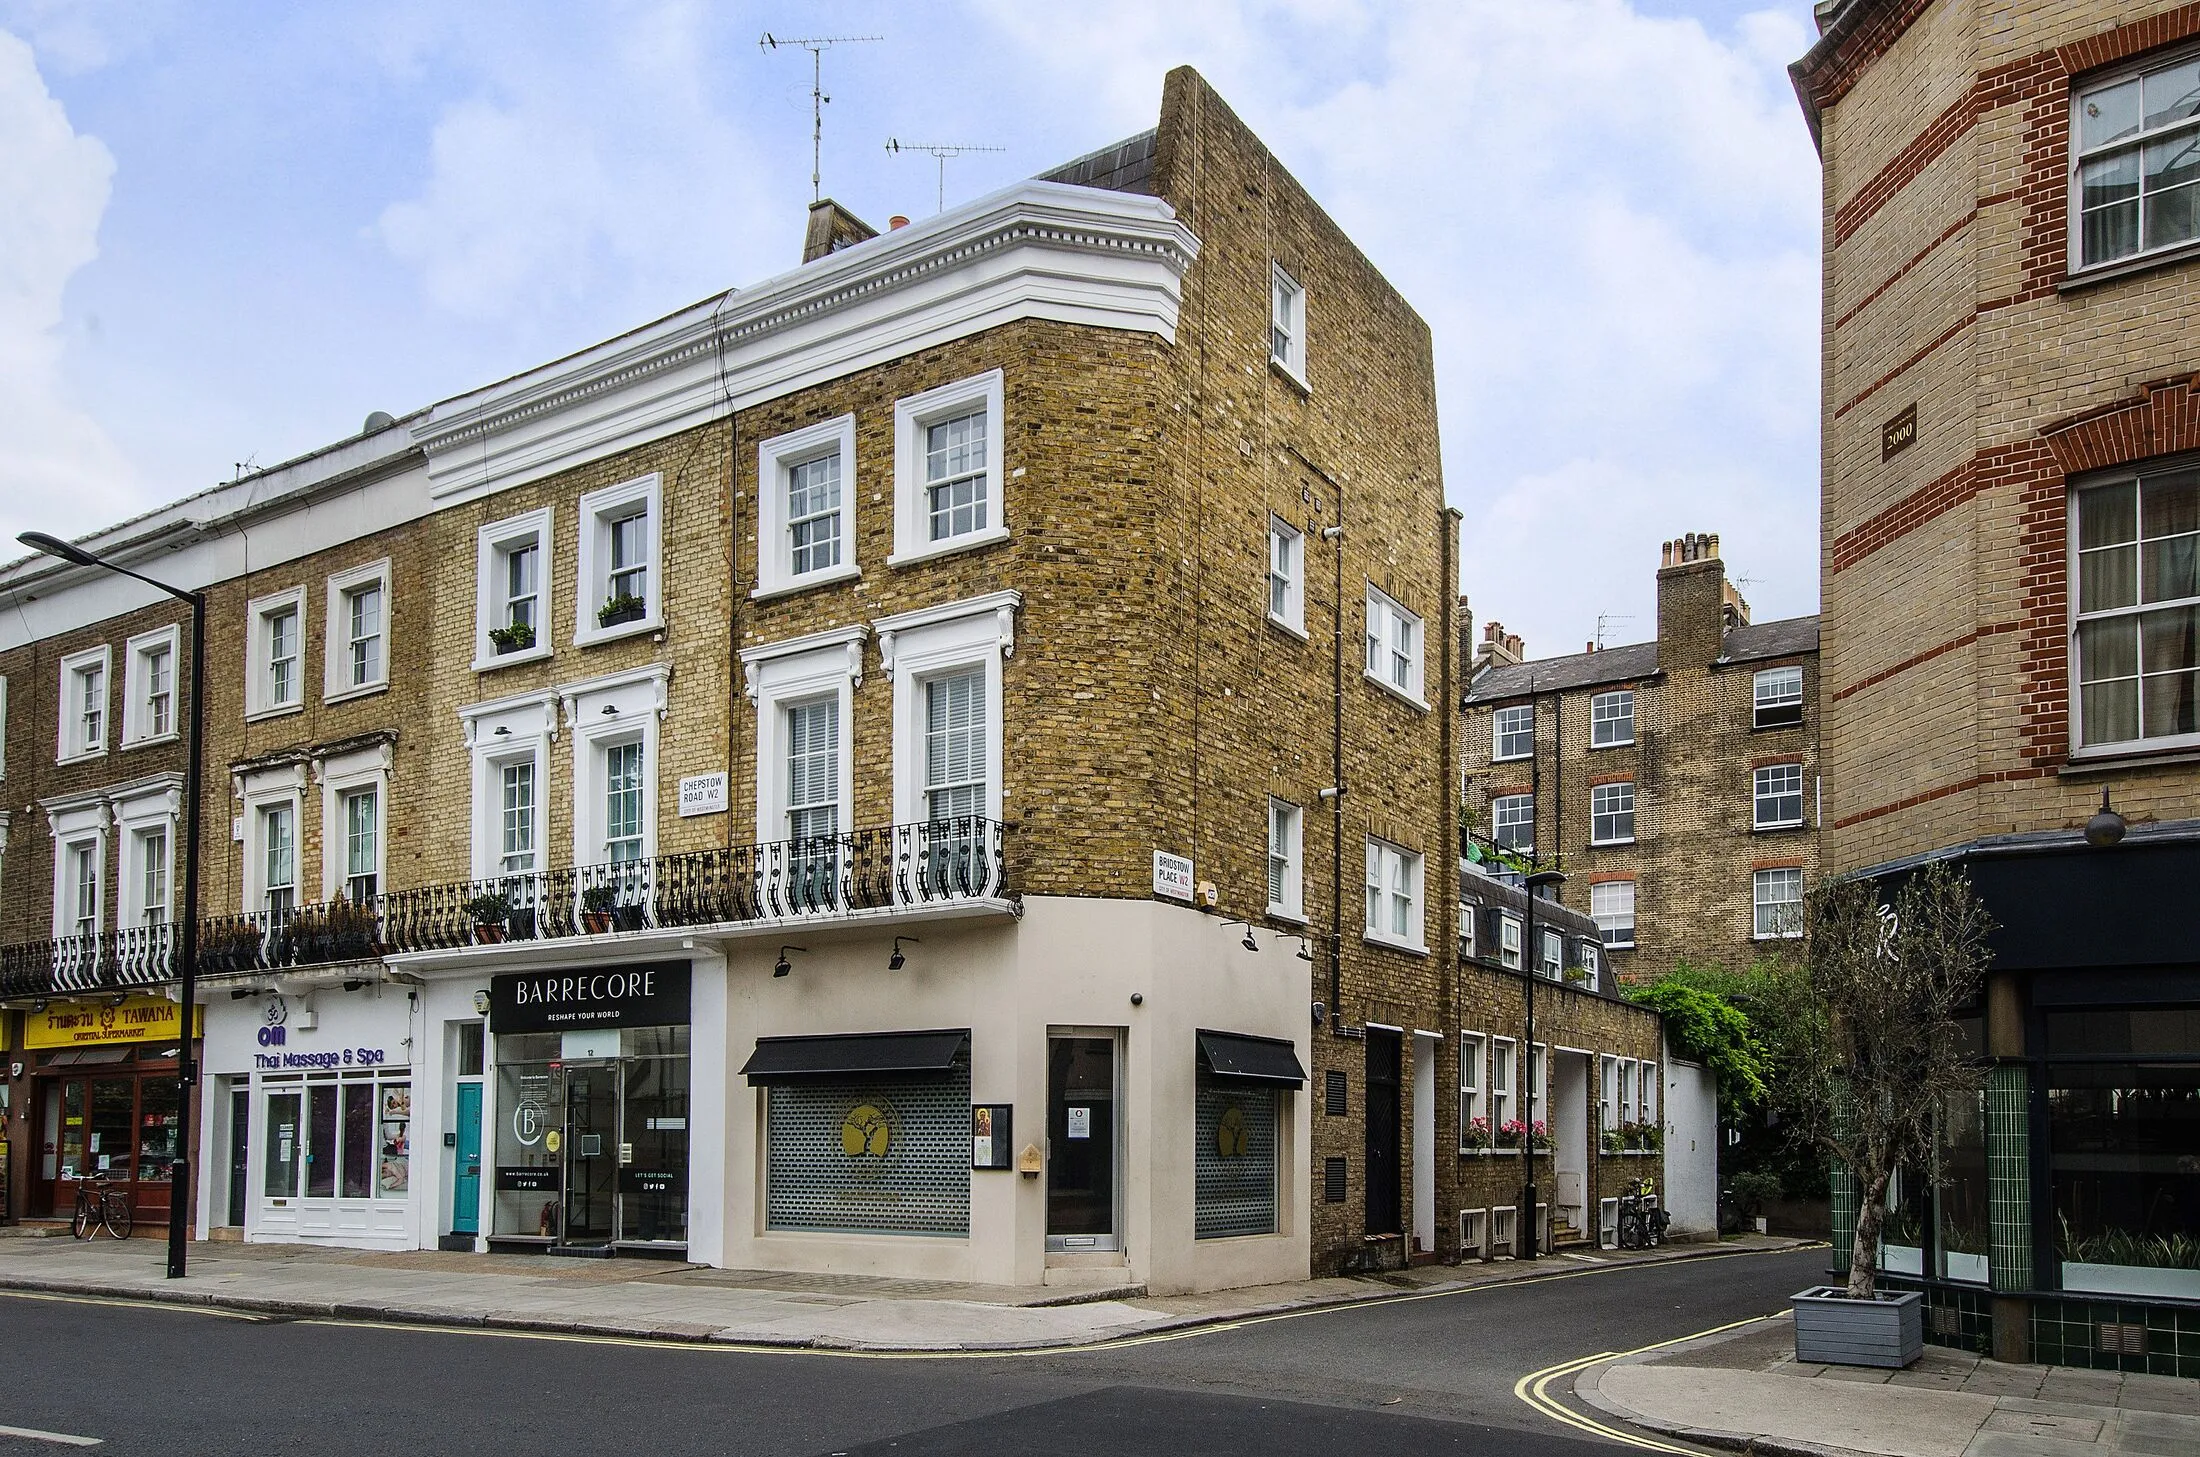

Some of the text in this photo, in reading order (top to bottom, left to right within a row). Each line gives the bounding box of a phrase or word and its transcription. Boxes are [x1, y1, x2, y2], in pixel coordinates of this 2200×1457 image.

[1887, 422, 1913, 450] 2000
[683, 776, 723, 792] CHEPSTOW
[683, 788, 719, 803] ROAD W2
[1158, 855, 1190, 874] BRIDSTOW
[1158, 869, 1189, 887] PLACE W2
[516, 971, 656, 1005] BARRECORE
[122, 1005, 175, 1025] TAWANA
[547, 1010, 620, 1021] RESHAPE YOUR WORLD
[101, 1027, 146, 1039] SUPERMARKET
[254, 1047, 384, 1069] Thai Massage & Spa
[587, 1049, 594, 1057] 12
[523, 1108, 536, 1135] B
